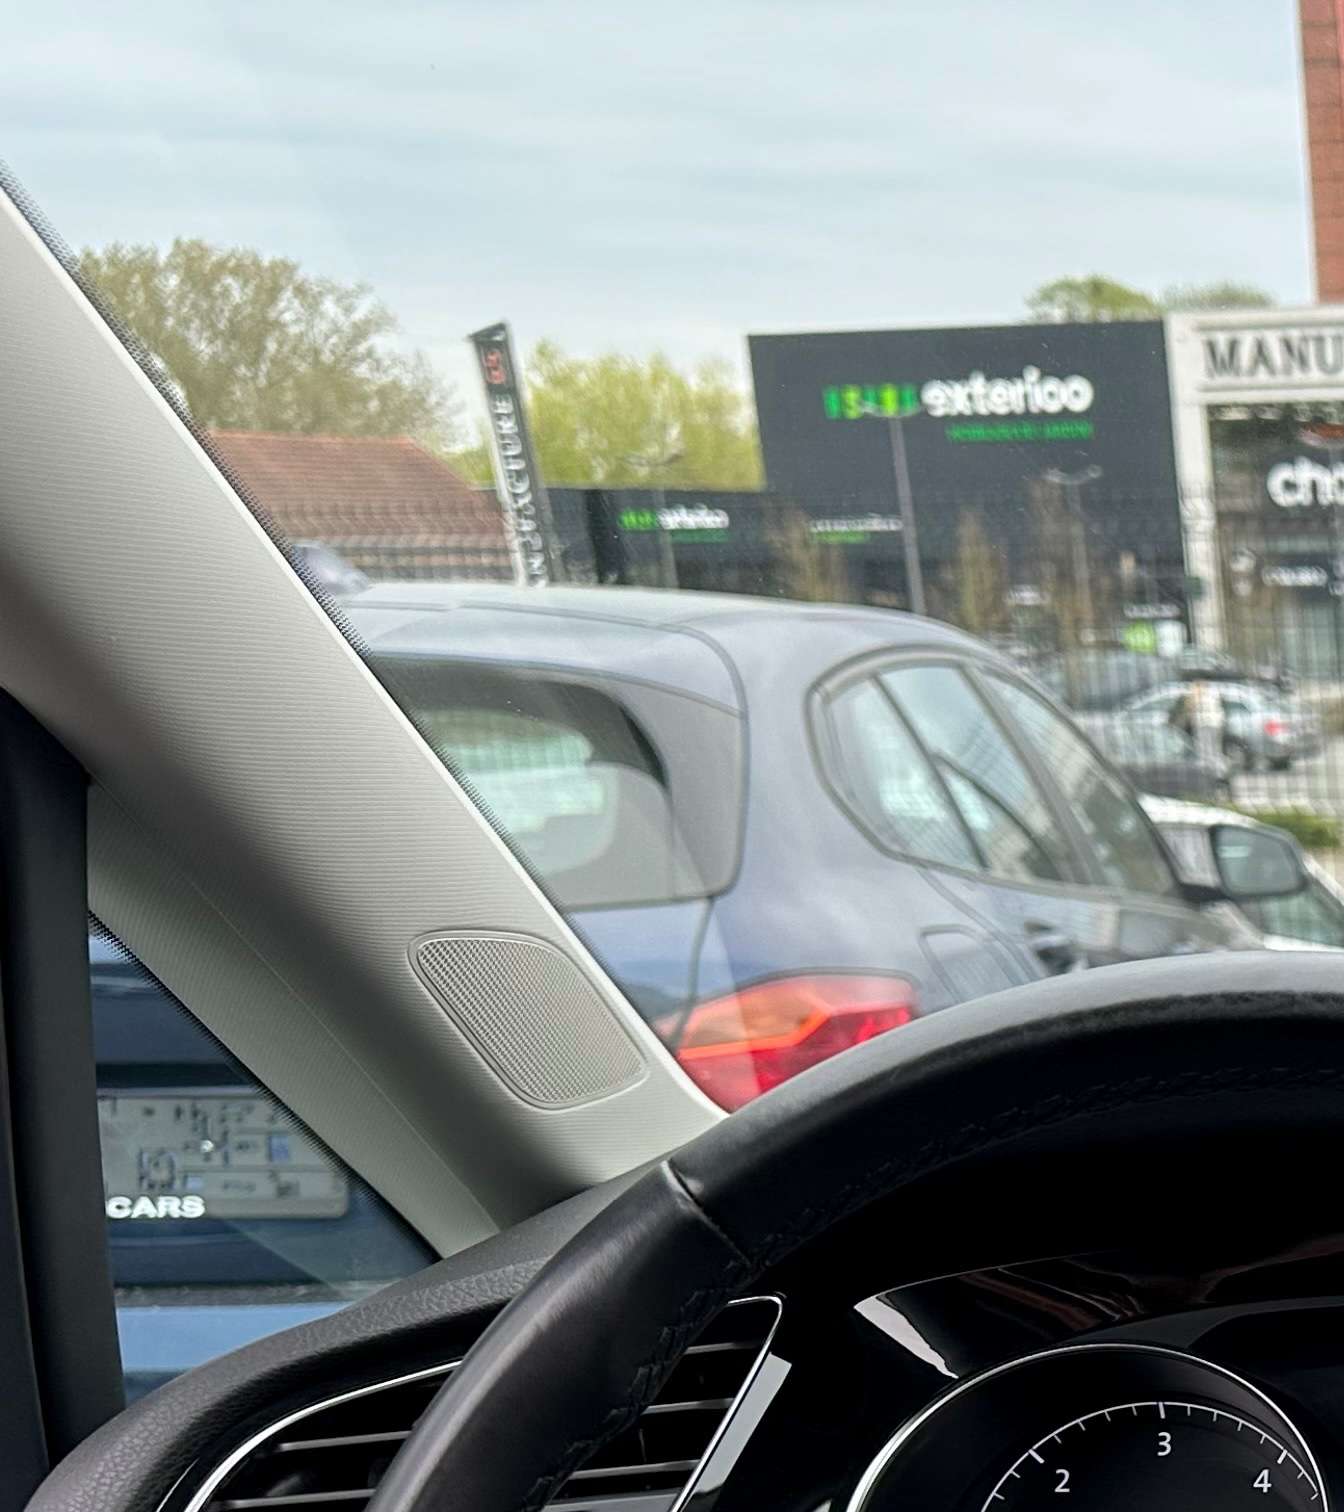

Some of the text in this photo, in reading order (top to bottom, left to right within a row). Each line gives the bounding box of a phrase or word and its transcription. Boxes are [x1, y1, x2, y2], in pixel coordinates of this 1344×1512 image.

[921, 365, 1095, 417] exterioo
[106, 1194, 206, 1219] CARS
[1158, 1432, 1171, 1456] 3
[1055, 1469, 1069, 1492] 2
[1254, 1470, 1271, 1492] 4
